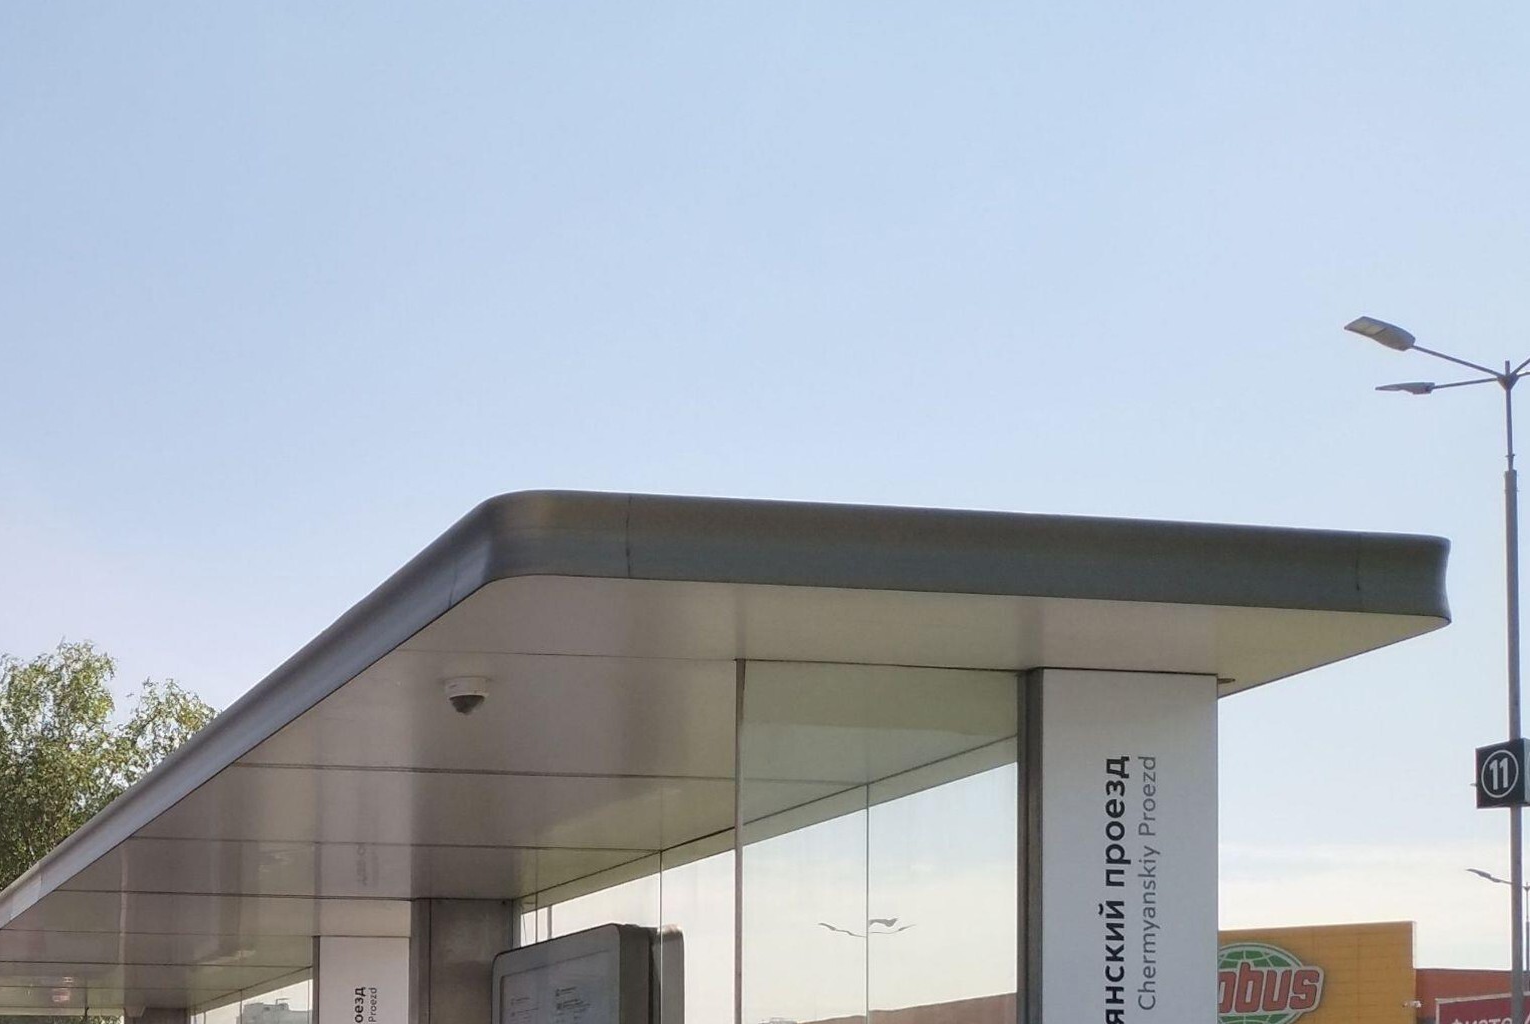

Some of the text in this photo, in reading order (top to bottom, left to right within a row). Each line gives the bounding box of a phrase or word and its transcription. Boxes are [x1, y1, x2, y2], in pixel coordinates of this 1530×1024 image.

[1489, 757, 1509, 790] 11
[1104, 755, 1131, 887] проезд
[1137, 755, 1161, 1011] Chermyanskiy Proezd
[368, 987, 378, 1023] Proezd
